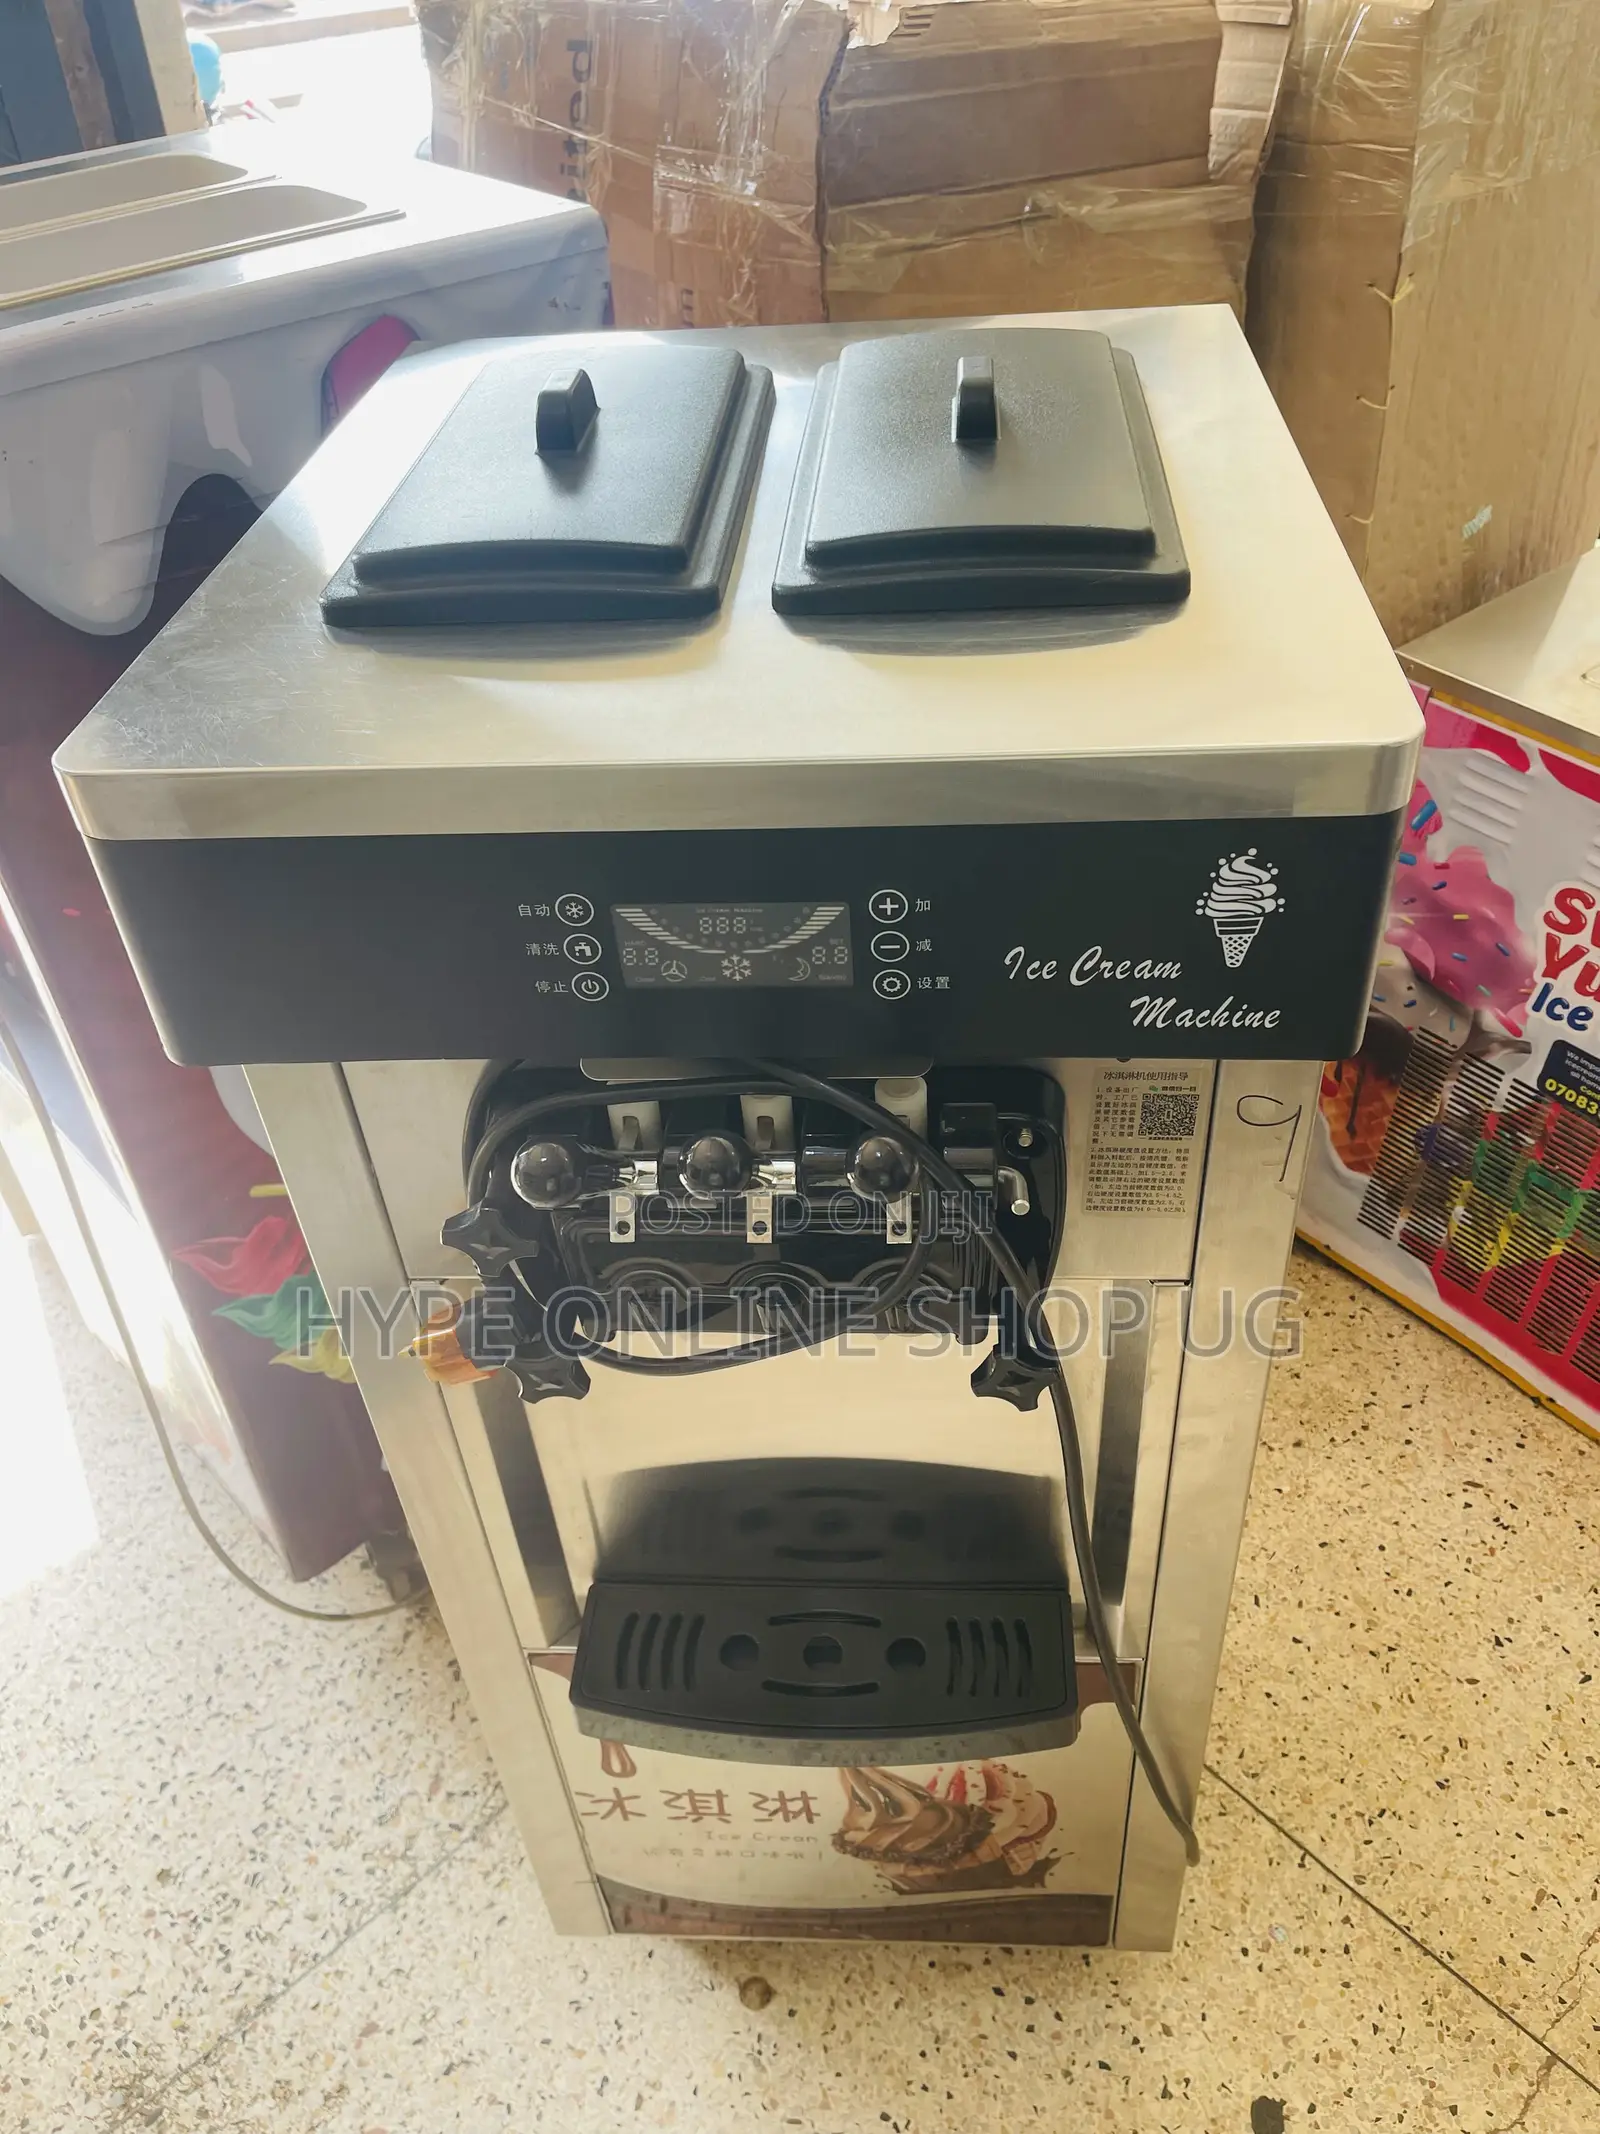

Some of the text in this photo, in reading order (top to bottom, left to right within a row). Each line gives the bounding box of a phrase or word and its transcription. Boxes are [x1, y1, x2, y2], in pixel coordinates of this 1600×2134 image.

[518, 904, 550, 917] 自动
[915, 898, 931, 912] 加
[1543, 887, 1600, 948] S
[525, 943, 560, 956] 清洗
[916, 939, 932, 952] 减
[1004, 945, 1183, 986] Ice Cream
[535, 981, 569, 993] 停止
[917, 976, 950, 989] 设置
[1129, 995, 1281, 1029] Machine
[1532, 982, 1594, 1031] Ice
[1545, 1078, 1600, 1115] 07083
[574, 1787, 821, 1823] 冰淇淋
